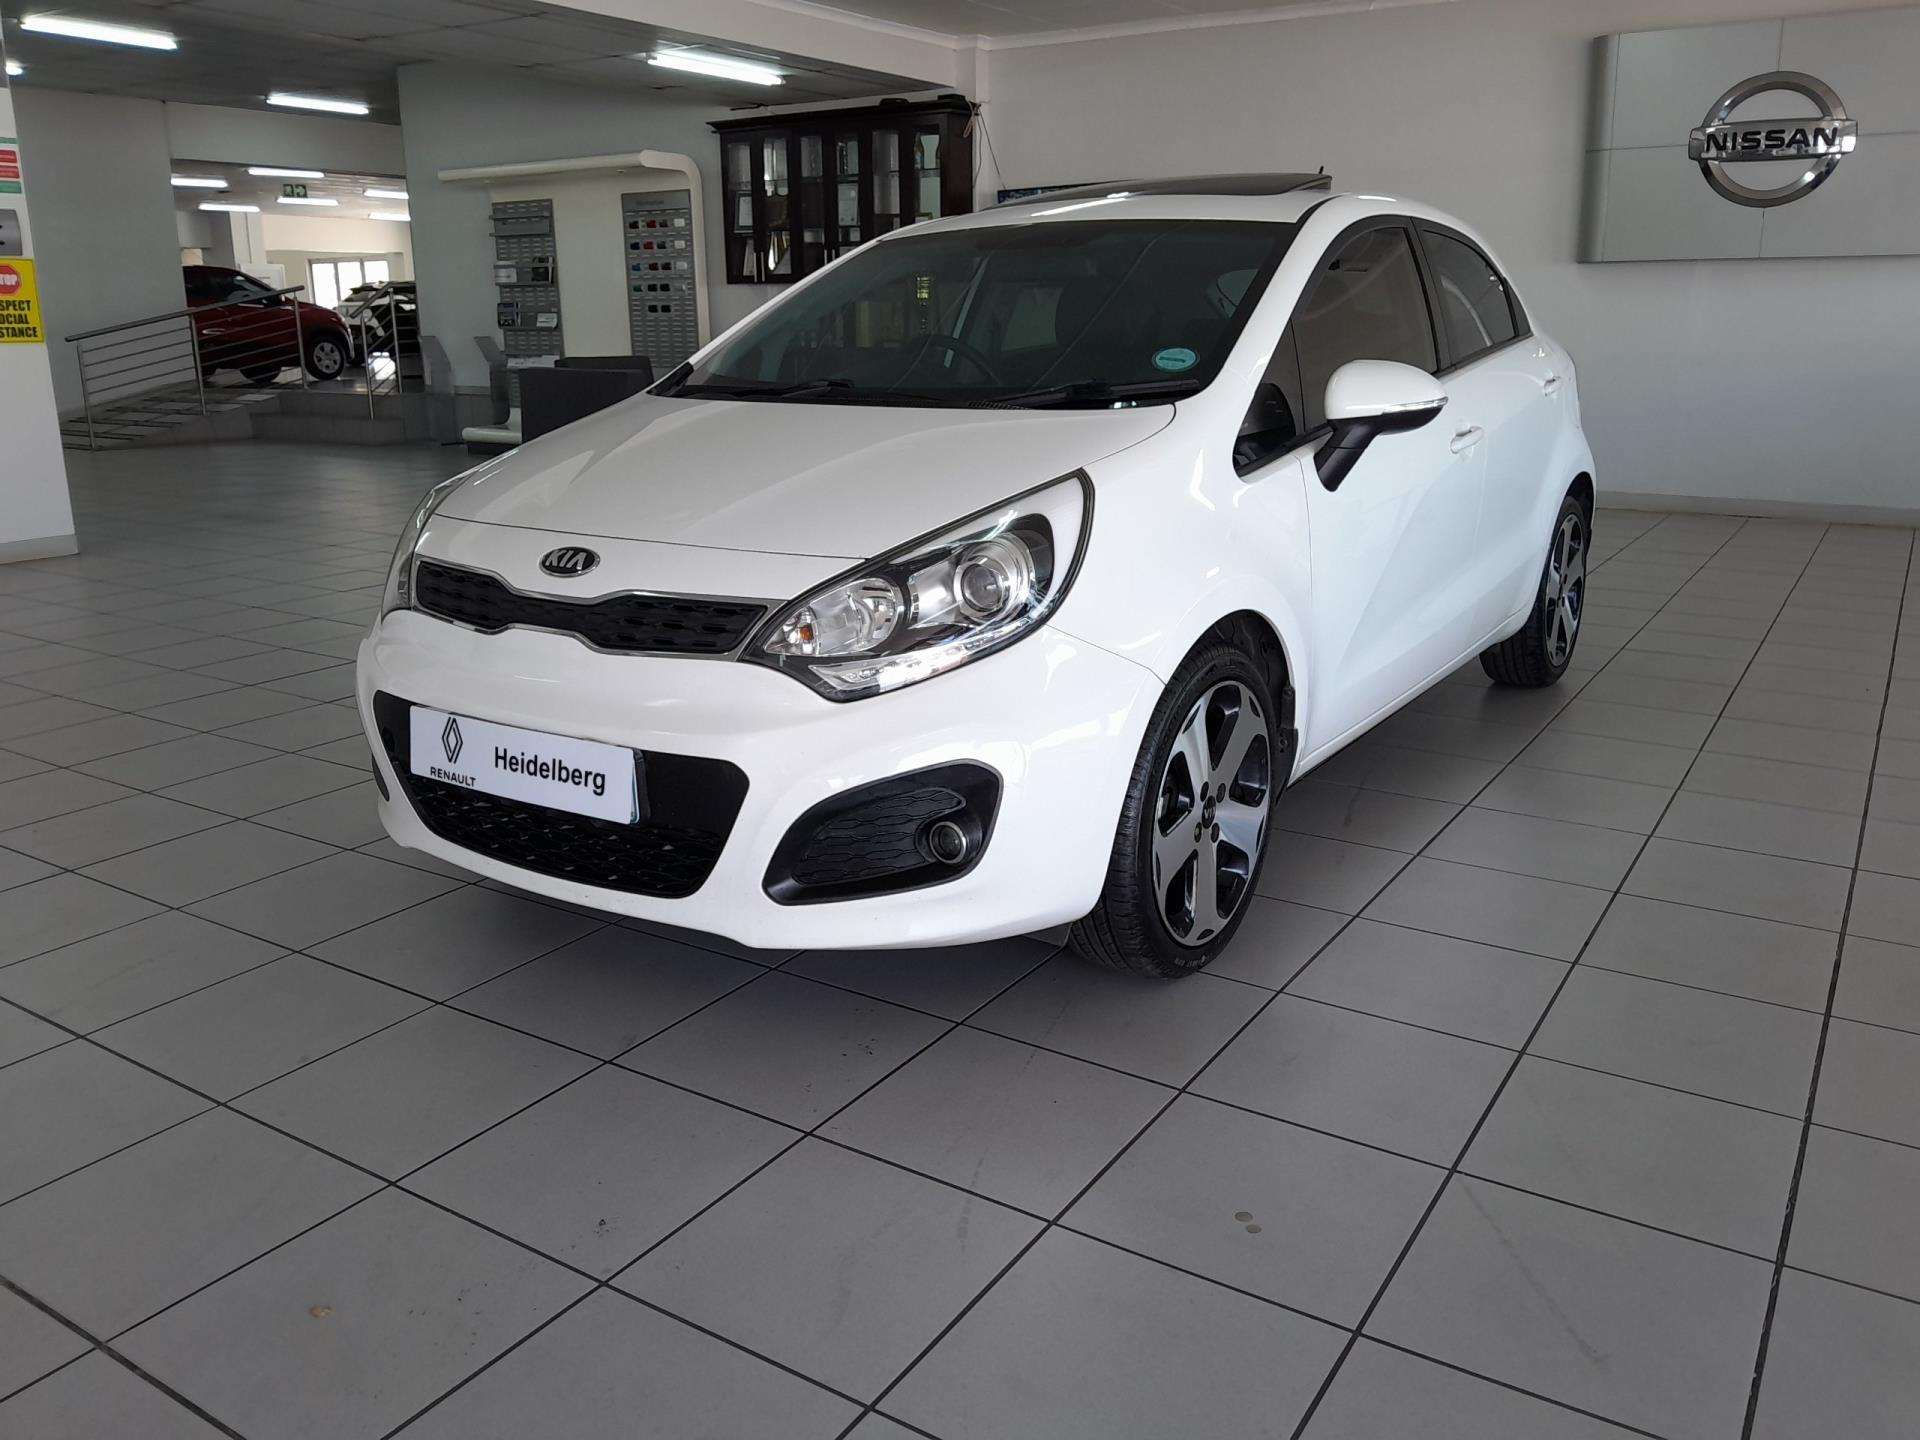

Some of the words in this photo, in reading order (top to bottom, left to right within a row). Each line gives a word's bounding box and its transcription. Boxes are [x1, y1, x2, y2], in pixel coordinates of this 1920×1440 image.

[1705, 127, 1838, 152] NISSAN
[545, 549, 587, 570] KIA
[430, 766, 476, 788] RENAULT
[494, 746, 606, 796] Heidelberg
